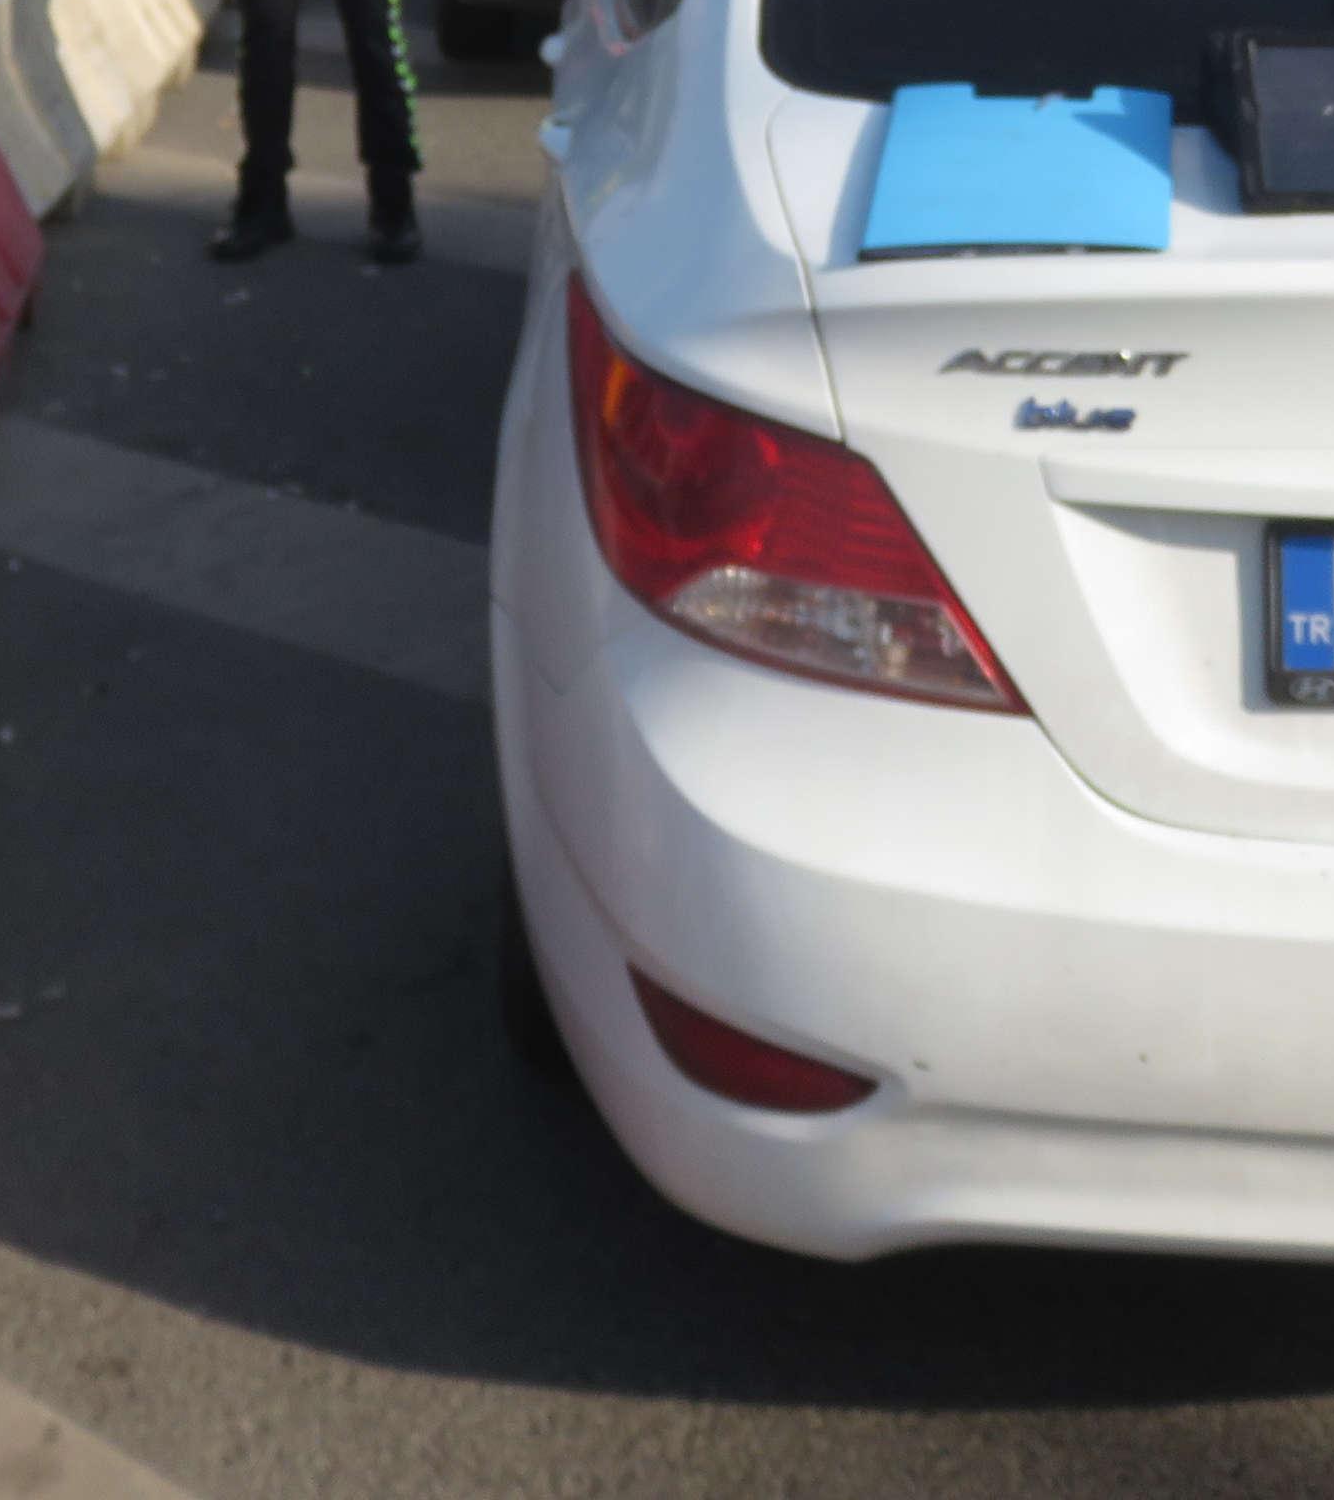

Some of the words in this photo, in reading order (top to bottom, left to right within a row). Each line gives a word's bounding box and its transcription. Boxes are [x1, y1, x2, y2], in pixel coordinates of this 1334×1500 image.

[936, 348, 1192, 377] ACCENT
[1013, 397, 1136, 431] blue
[1288, 613, 1332, 645] TR
